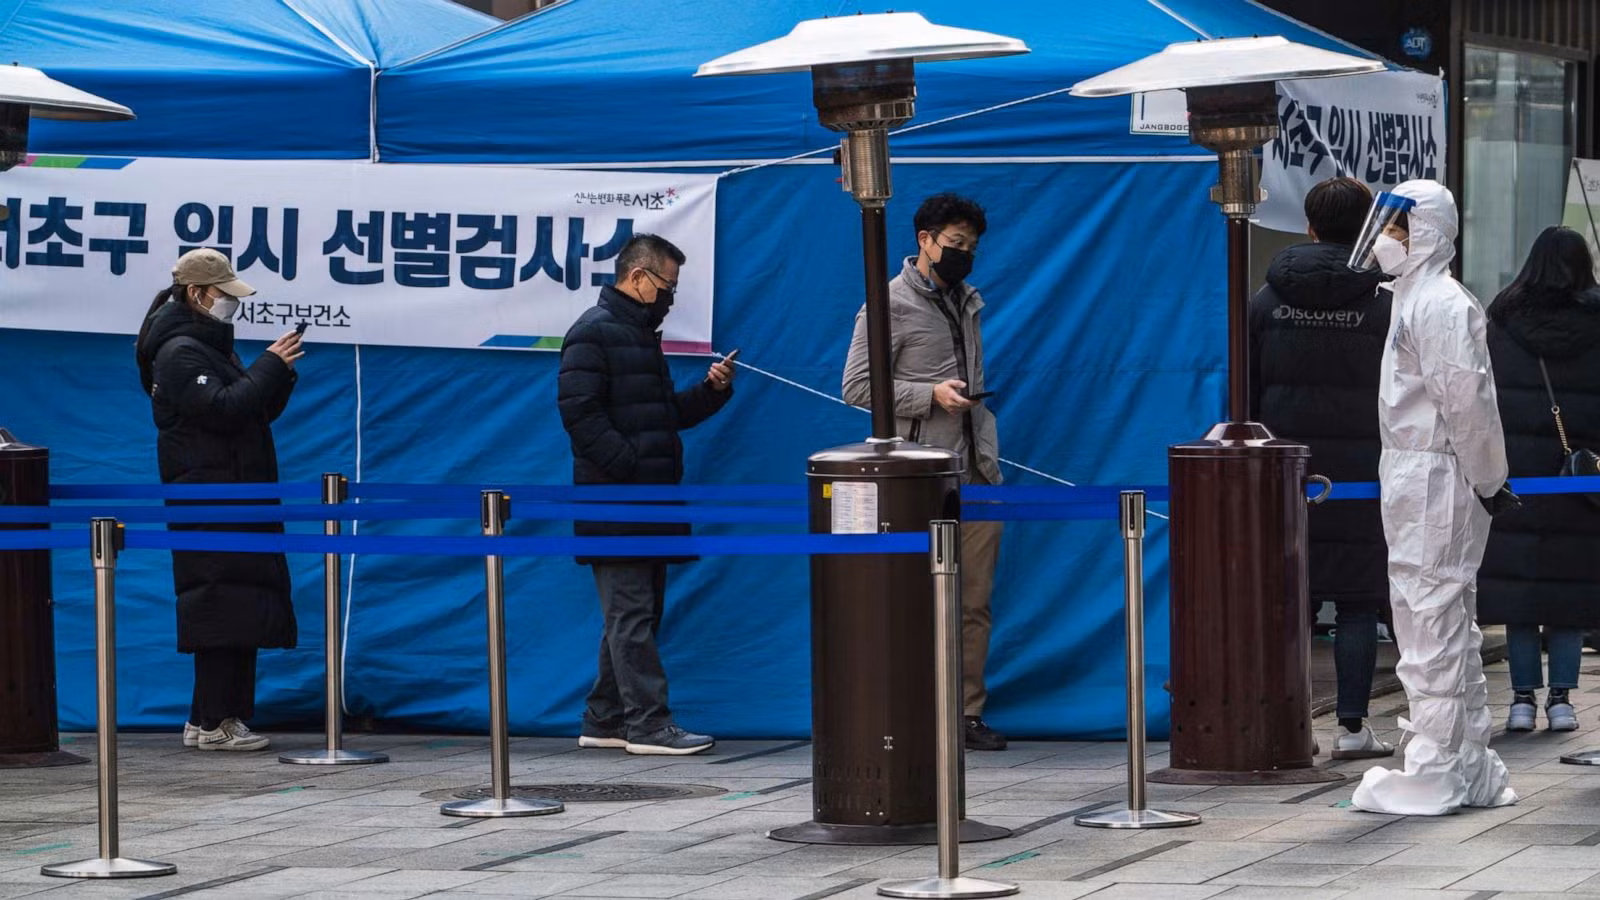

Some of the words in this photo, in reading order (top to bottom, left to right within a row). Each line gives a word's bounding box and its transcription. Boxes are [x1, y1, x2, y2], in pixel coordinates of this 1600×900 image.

[1328, 105, 1362, 179] 임시
[1365, 111, 1437, 184] 선별검사소
[632, 192, 665, 210] 서초
[174, 202, 299, 281] 임시
[237, 301, 351, 327] 서초구보건소
